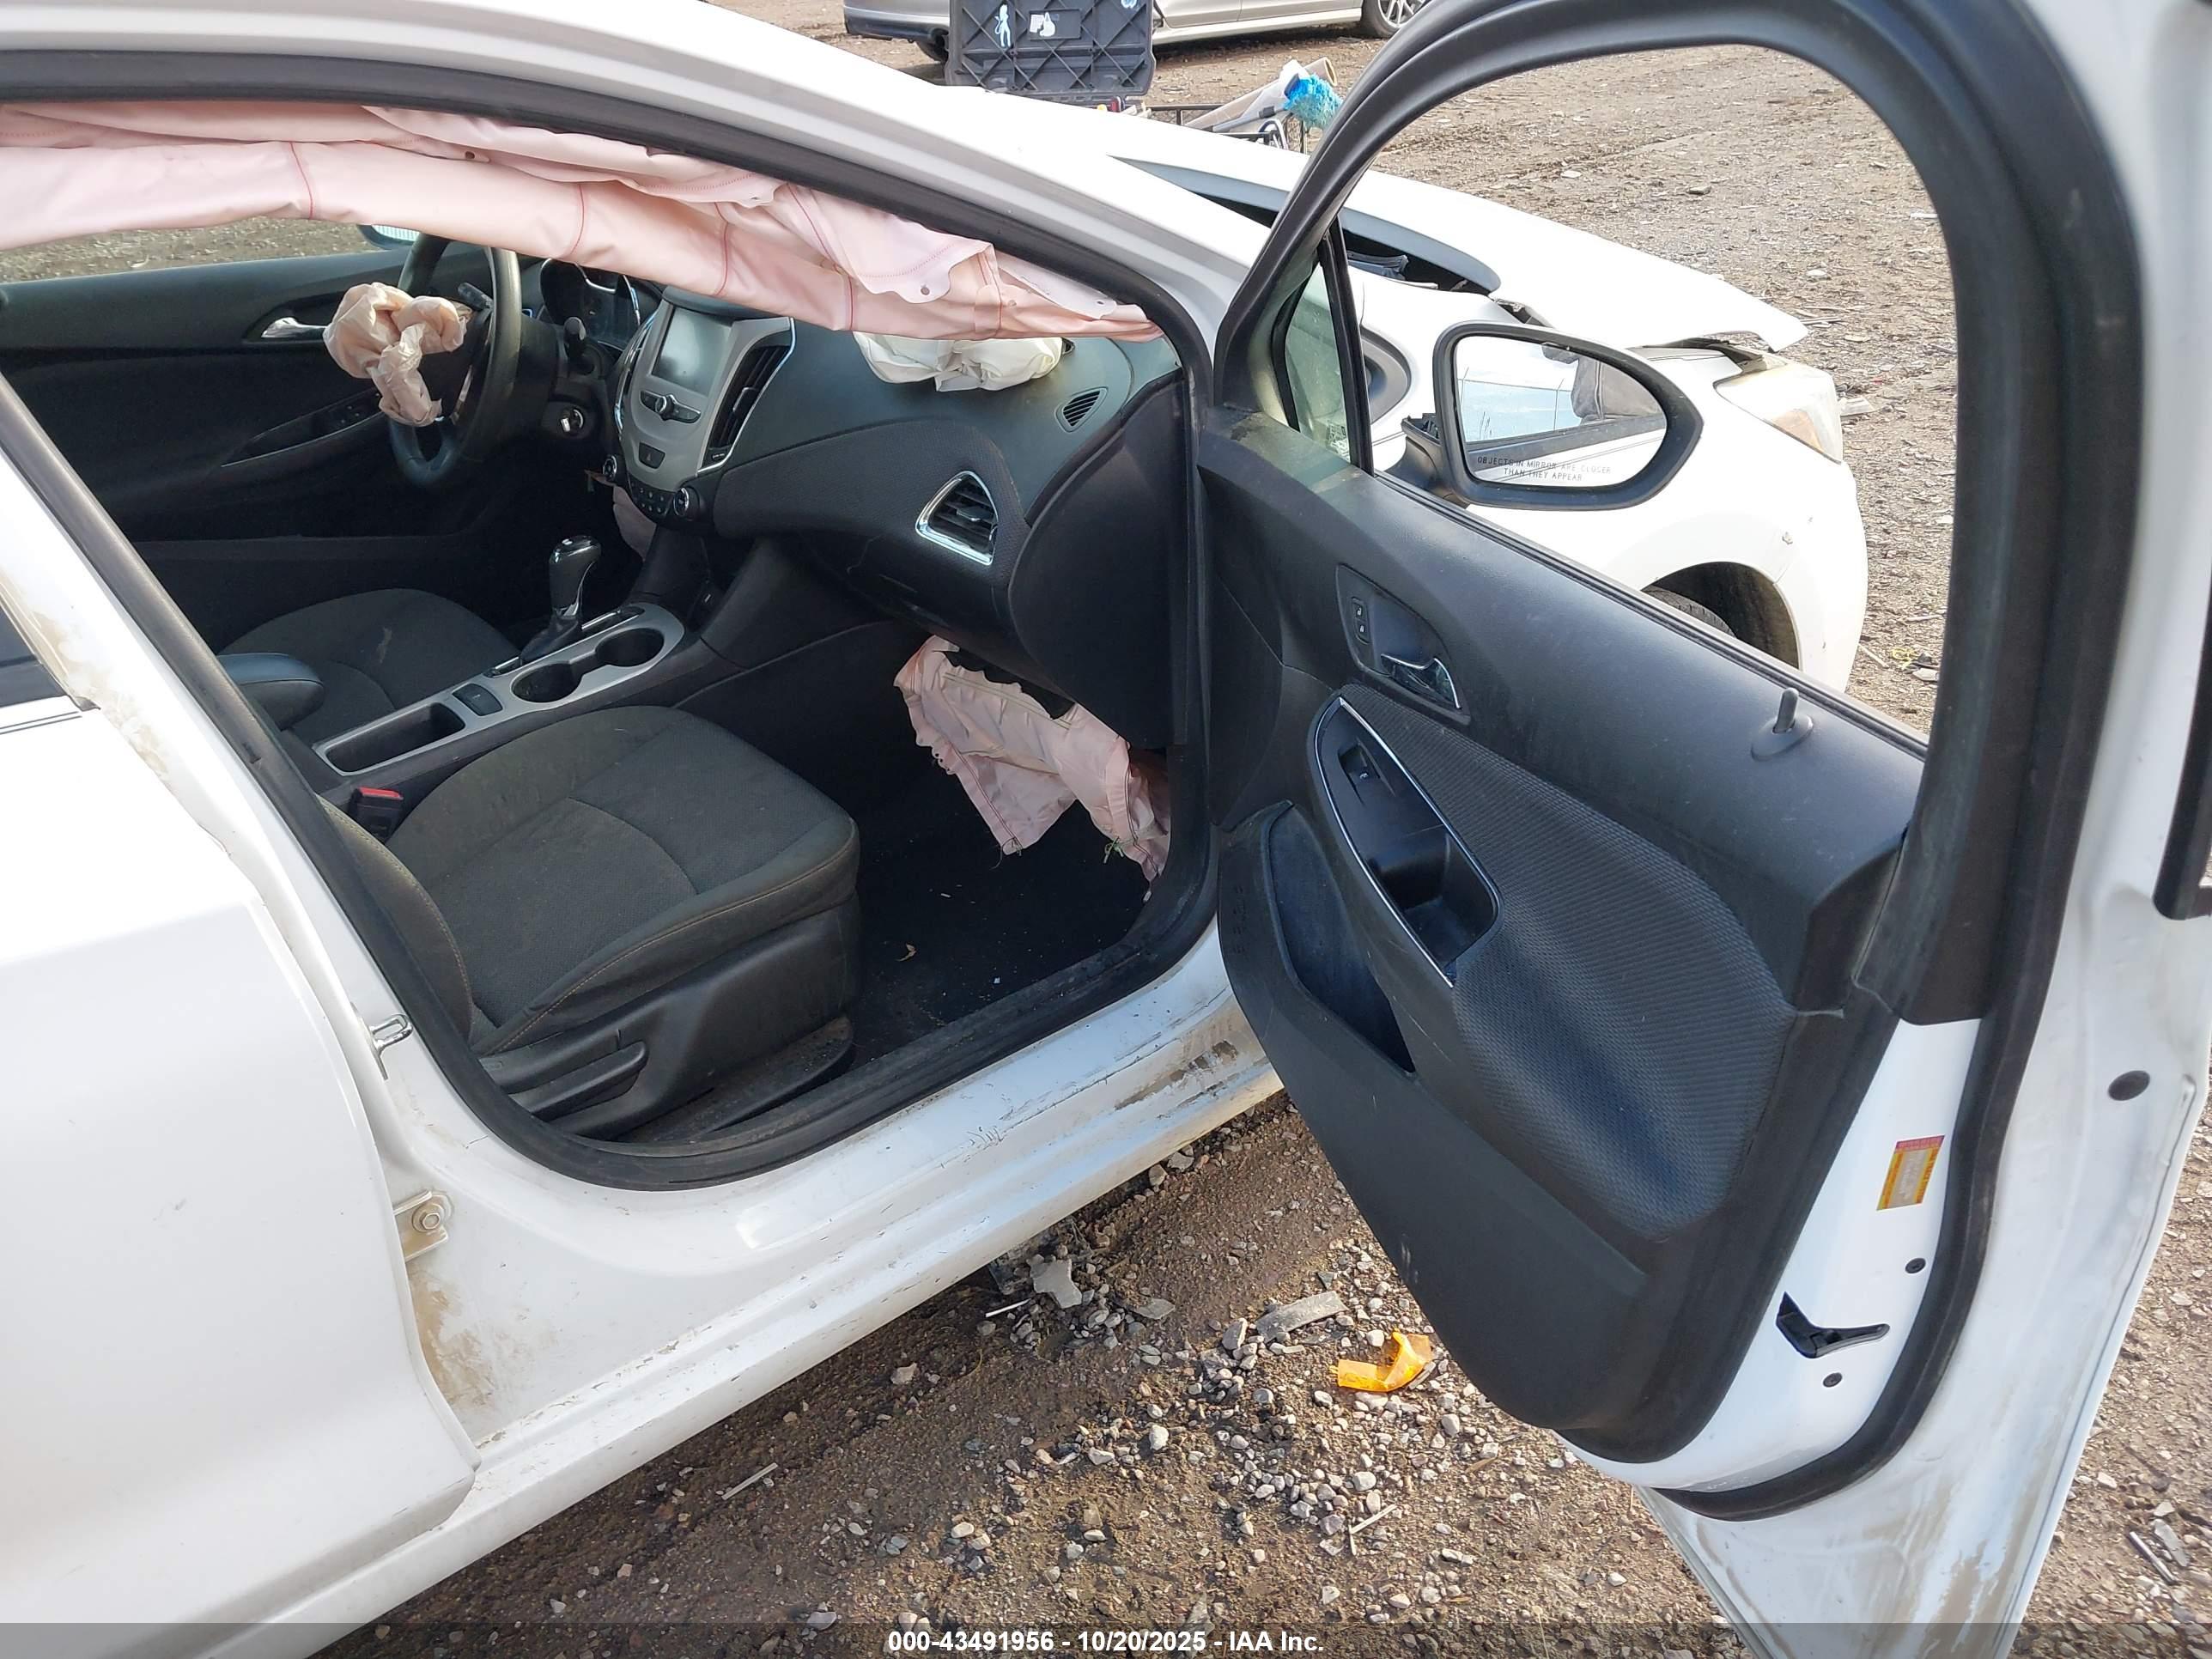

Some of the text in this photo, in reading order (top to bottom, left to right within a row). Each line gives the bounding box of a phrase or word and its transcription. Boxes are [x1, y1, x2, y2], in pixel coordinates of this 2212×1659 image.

[1477, 456, 1515, 466] OBJECTS
[1527, 460, 1557, 470] MIRROR
[1581, 465, 1611, 474] CLOSER
[1504, 467, 1583, 481] THAN THEY APPEAR
